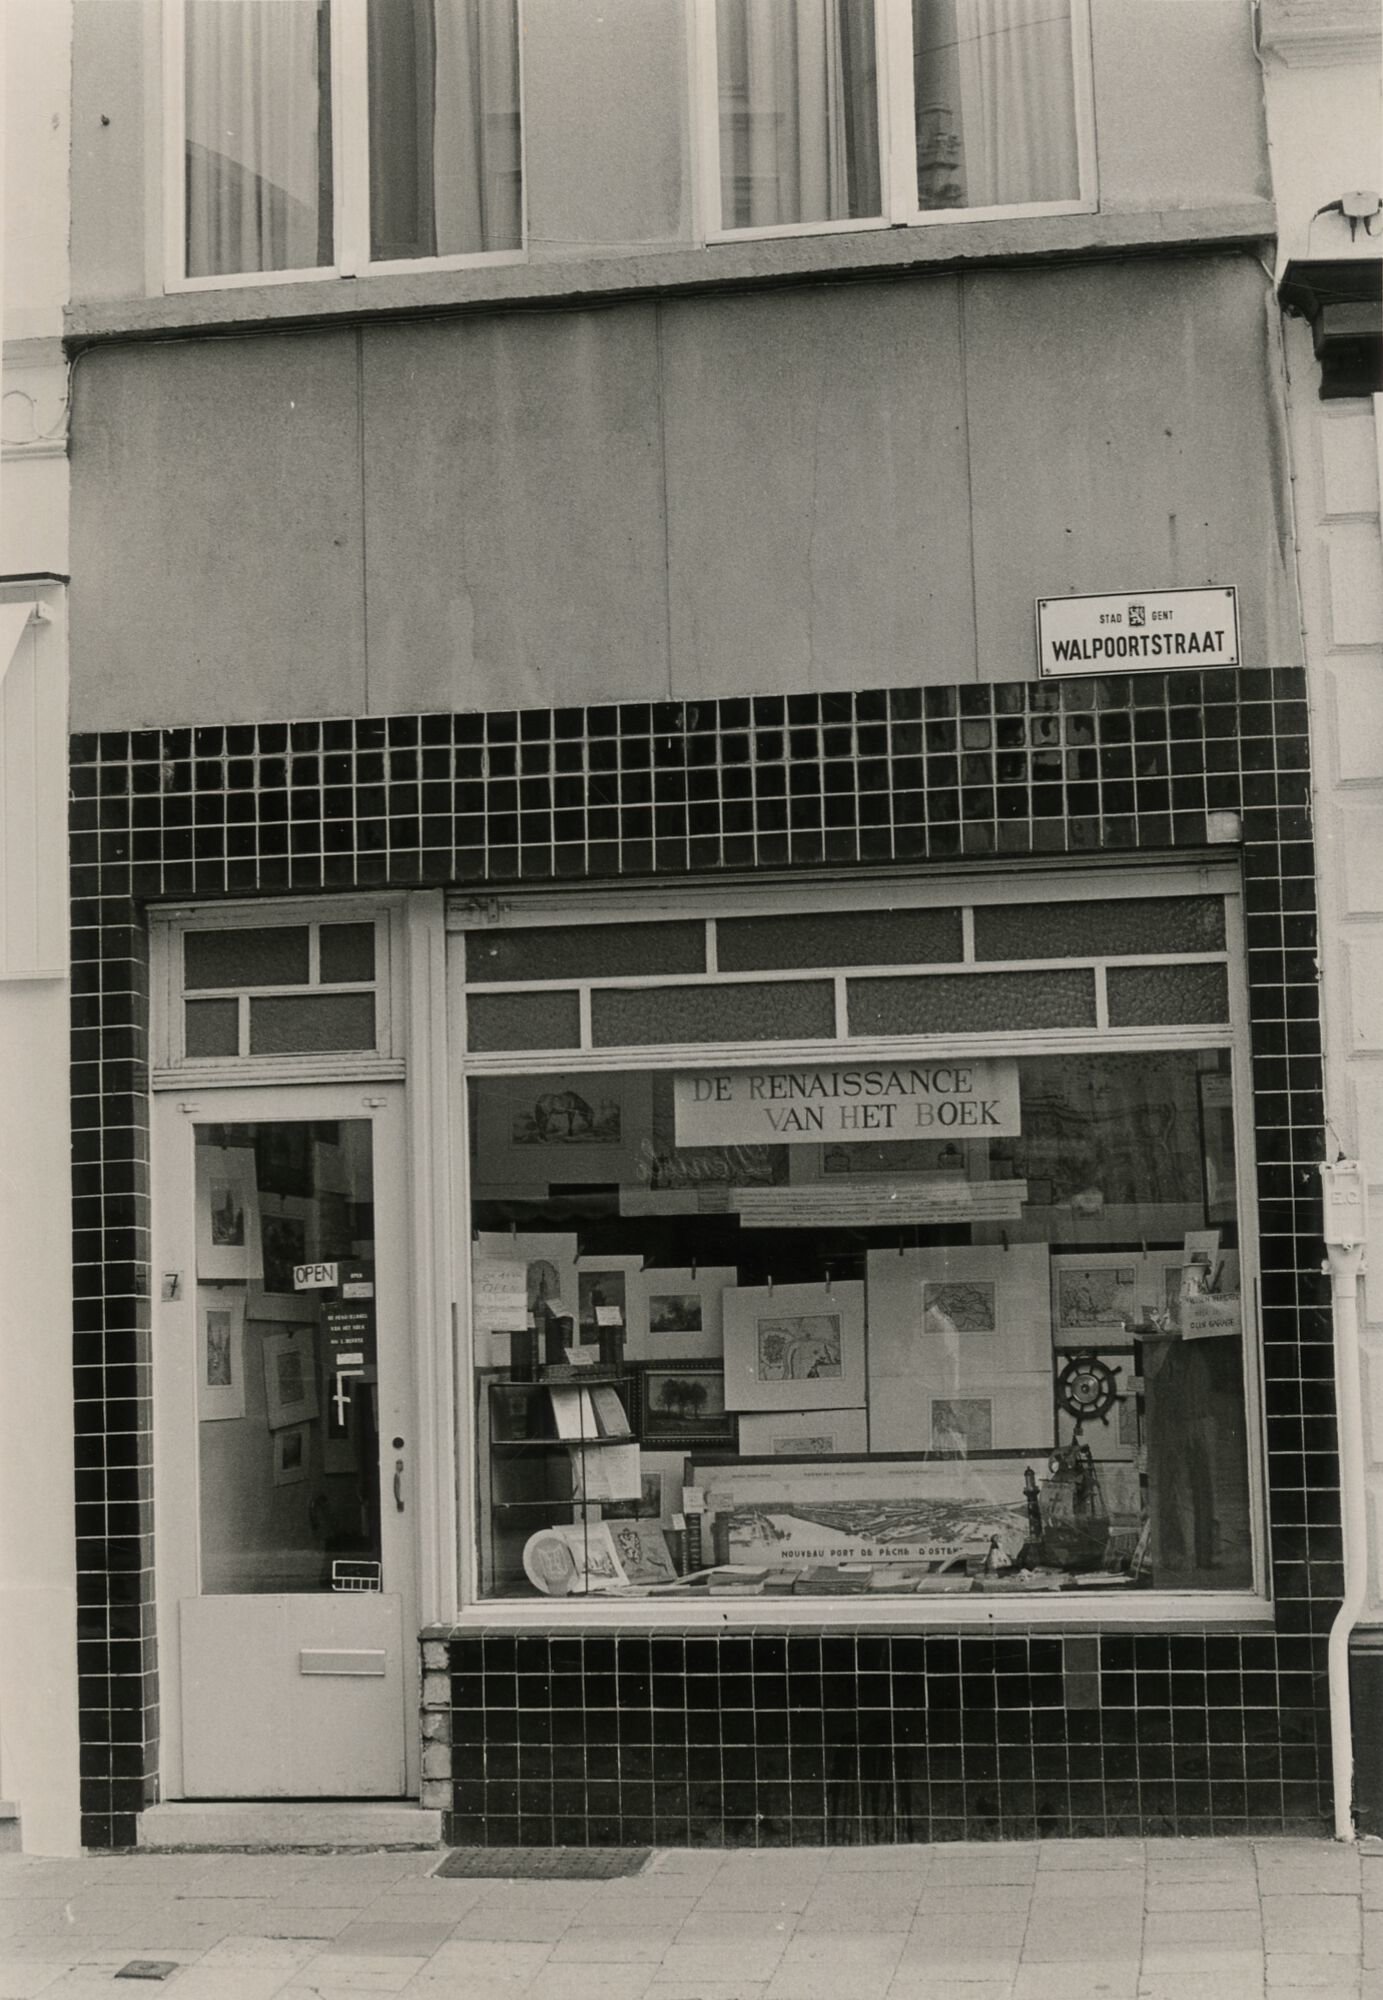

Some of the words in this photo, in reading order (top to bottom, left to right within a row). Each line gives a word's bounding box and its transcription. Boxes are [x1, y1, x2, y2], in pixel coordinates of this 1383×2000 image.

[1099, 613, 1122, 624] STAD
[1151, 610, 1174, 621] GENT
[1051, 630, 1225, 661] WALPOORTSTRAAT
[693, 1075, 733, 1101] DE
[748, 1067, 973, 1100] RENAISSANCE
[763, 1104, 825, 1132] VAN
[839, 1103, 898, 1129] HET
[914, 1100, 1002, 1127] BOEK
[165, 1273, 178, 1298] 7
[295, 1265, 334, 1284] OPEN
[781, 1549, 825, 1559] NOUVEAU
[829, 1547, 855, 1557] PORT
[860, 1547, 874, 1557] DE
